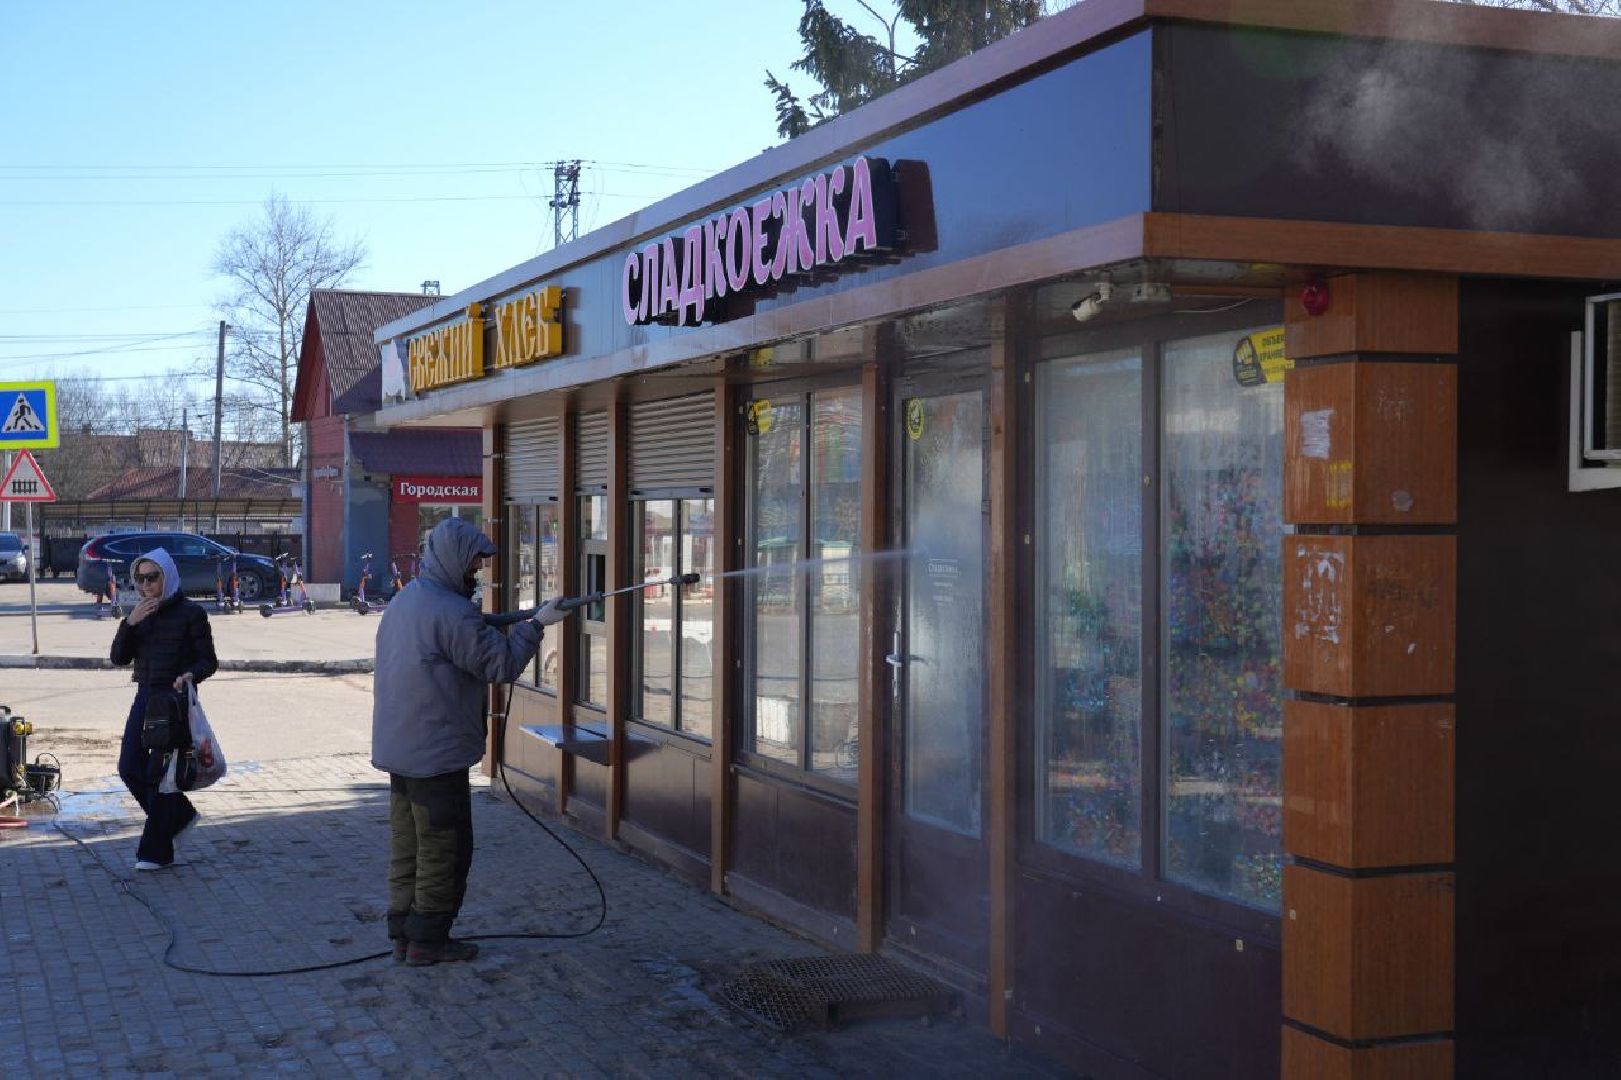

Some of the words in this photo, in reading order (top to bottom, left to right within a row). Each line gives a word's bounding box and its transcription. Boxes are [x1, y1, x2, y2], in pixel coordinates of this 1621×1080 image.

[622, 155, 877, 326] СЛАДКОЕЖКА
[408, 304, 475, 392] СВЕЖИЙ
[494, 287, 554, 369] ХЛЕБ
[400, 482, 479, 498] Городская
